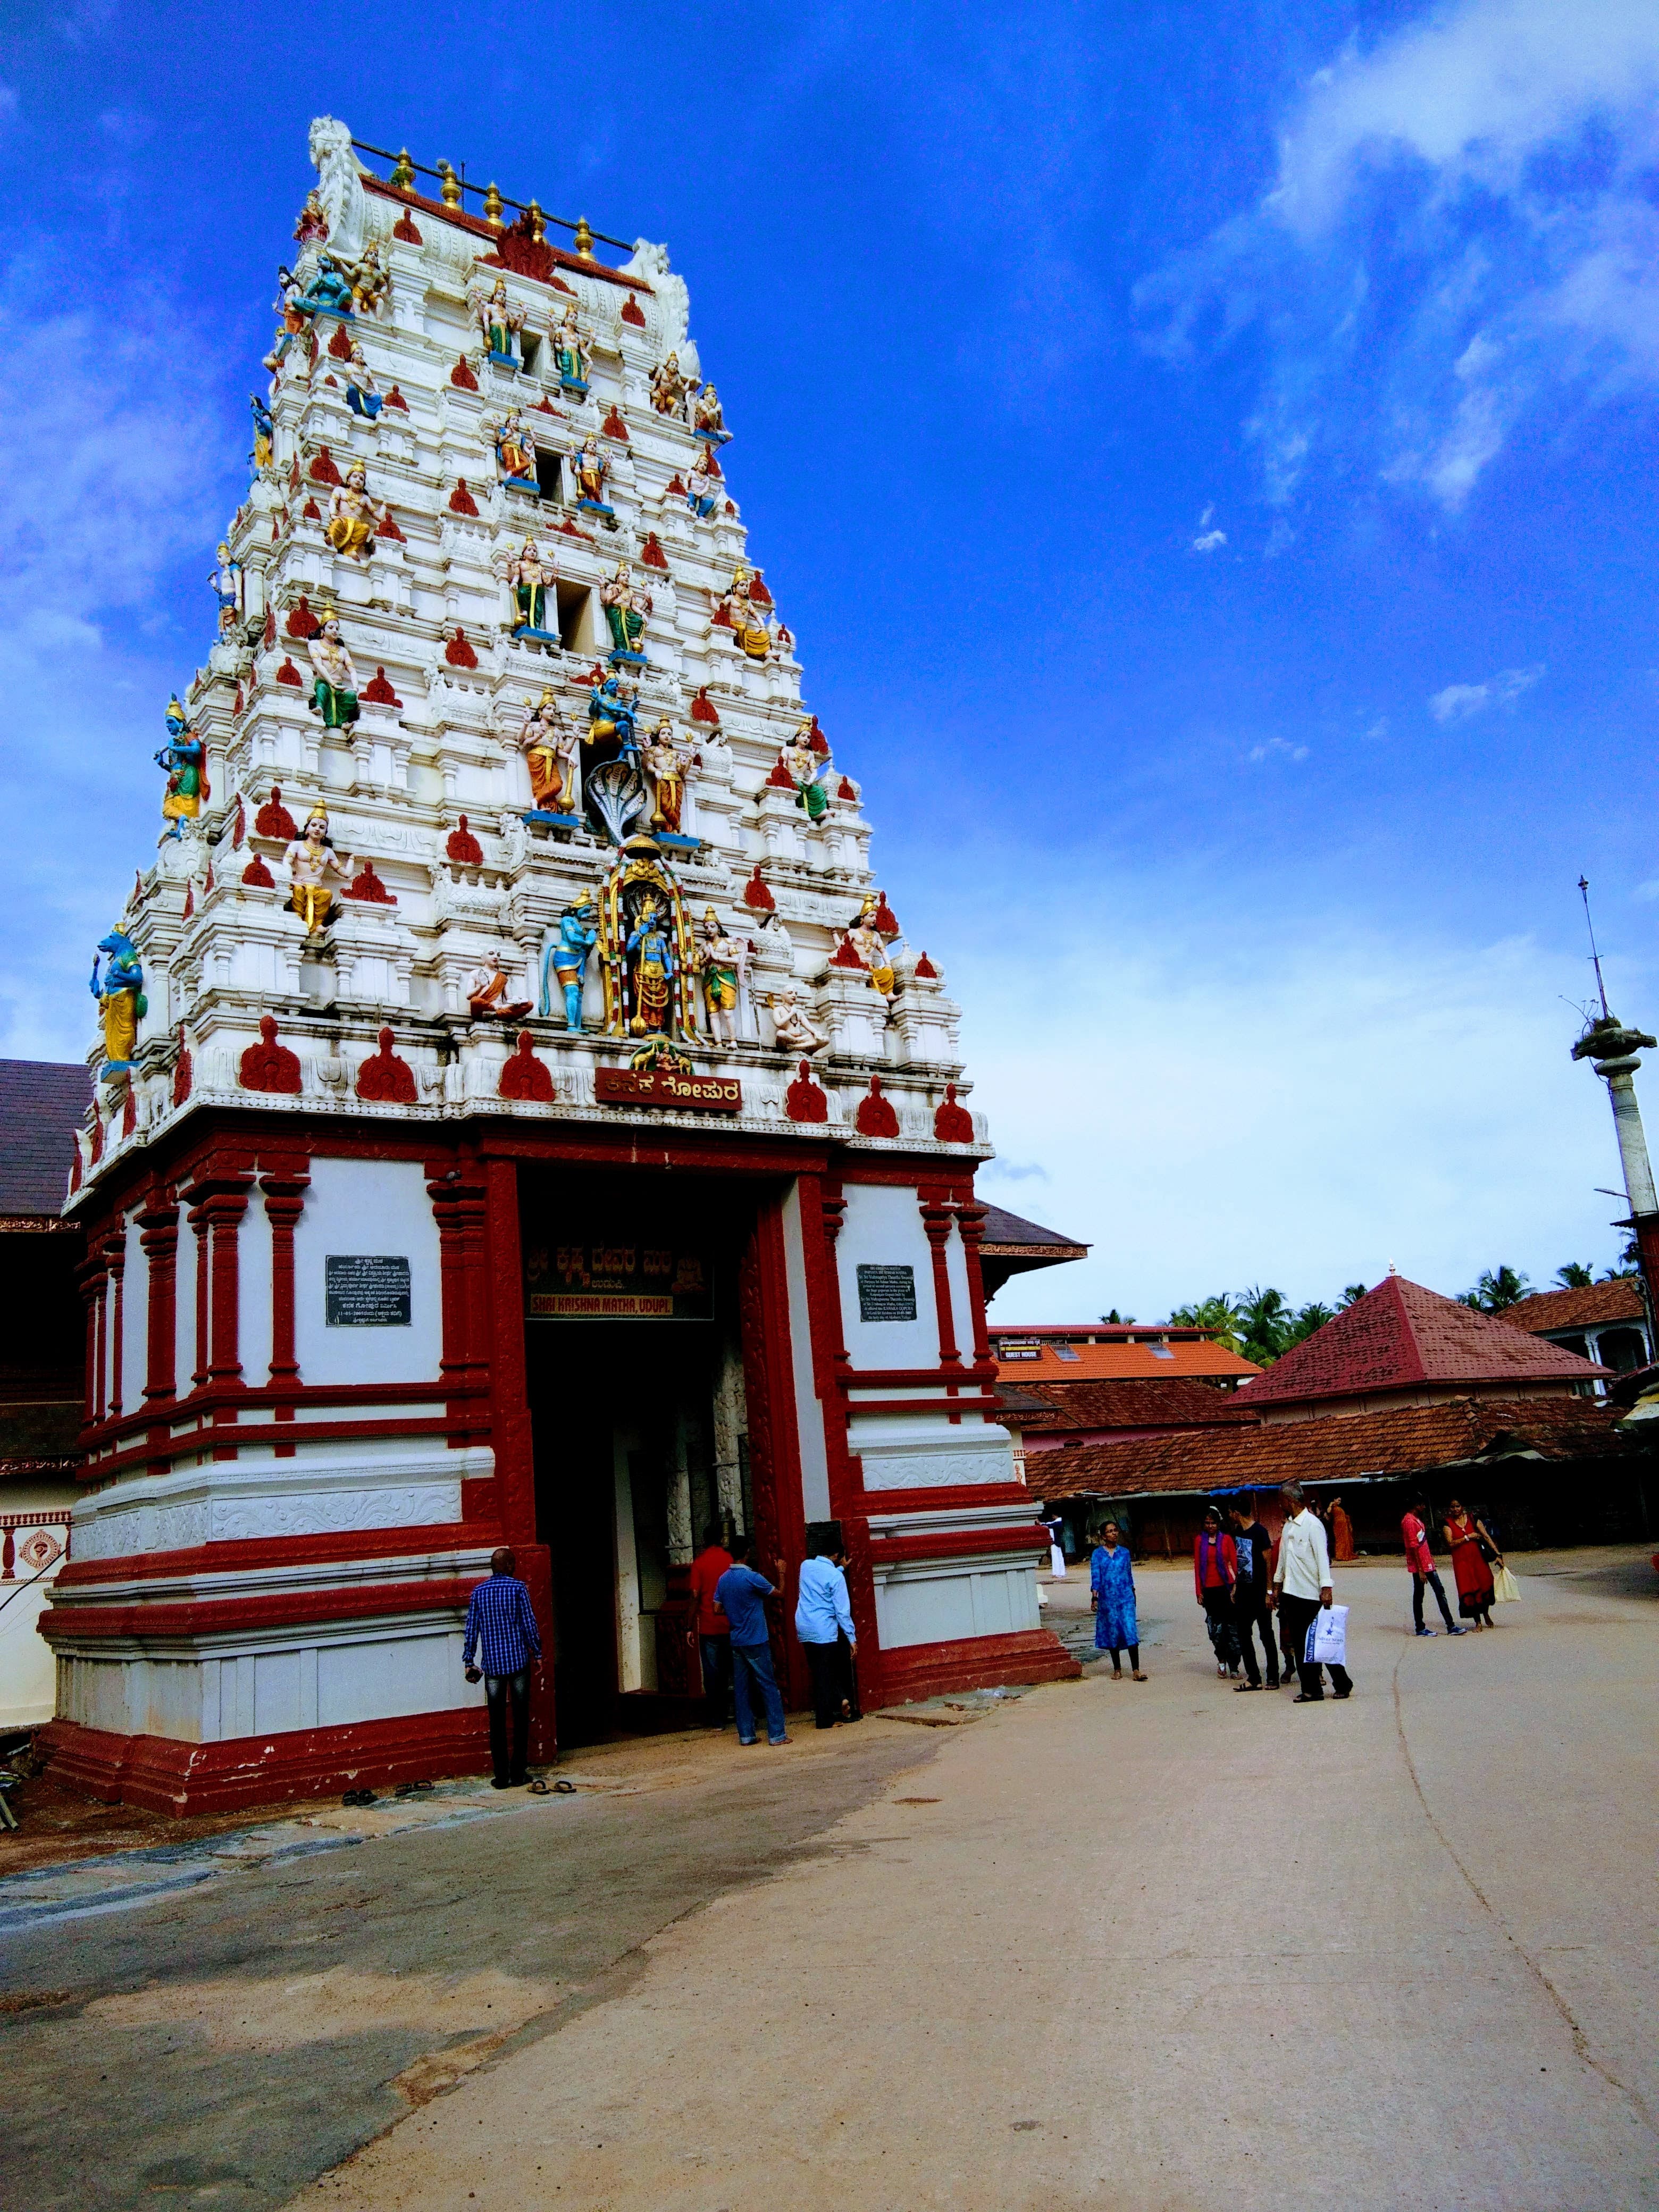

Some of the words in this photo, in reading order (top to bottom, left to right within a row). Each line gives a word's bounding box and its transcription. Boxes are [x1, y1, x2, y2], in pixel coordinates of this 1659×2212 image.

[661, 1073, 739, 1101] ಗೋಪುರ
[532, 1296, 555, 1311] SHRI
[558, 1297, 600, 1312] KRISHNA
[602, 1297, 639, 1314] MATHA,
[639, 1298, 671, 1313] UDUPI.
